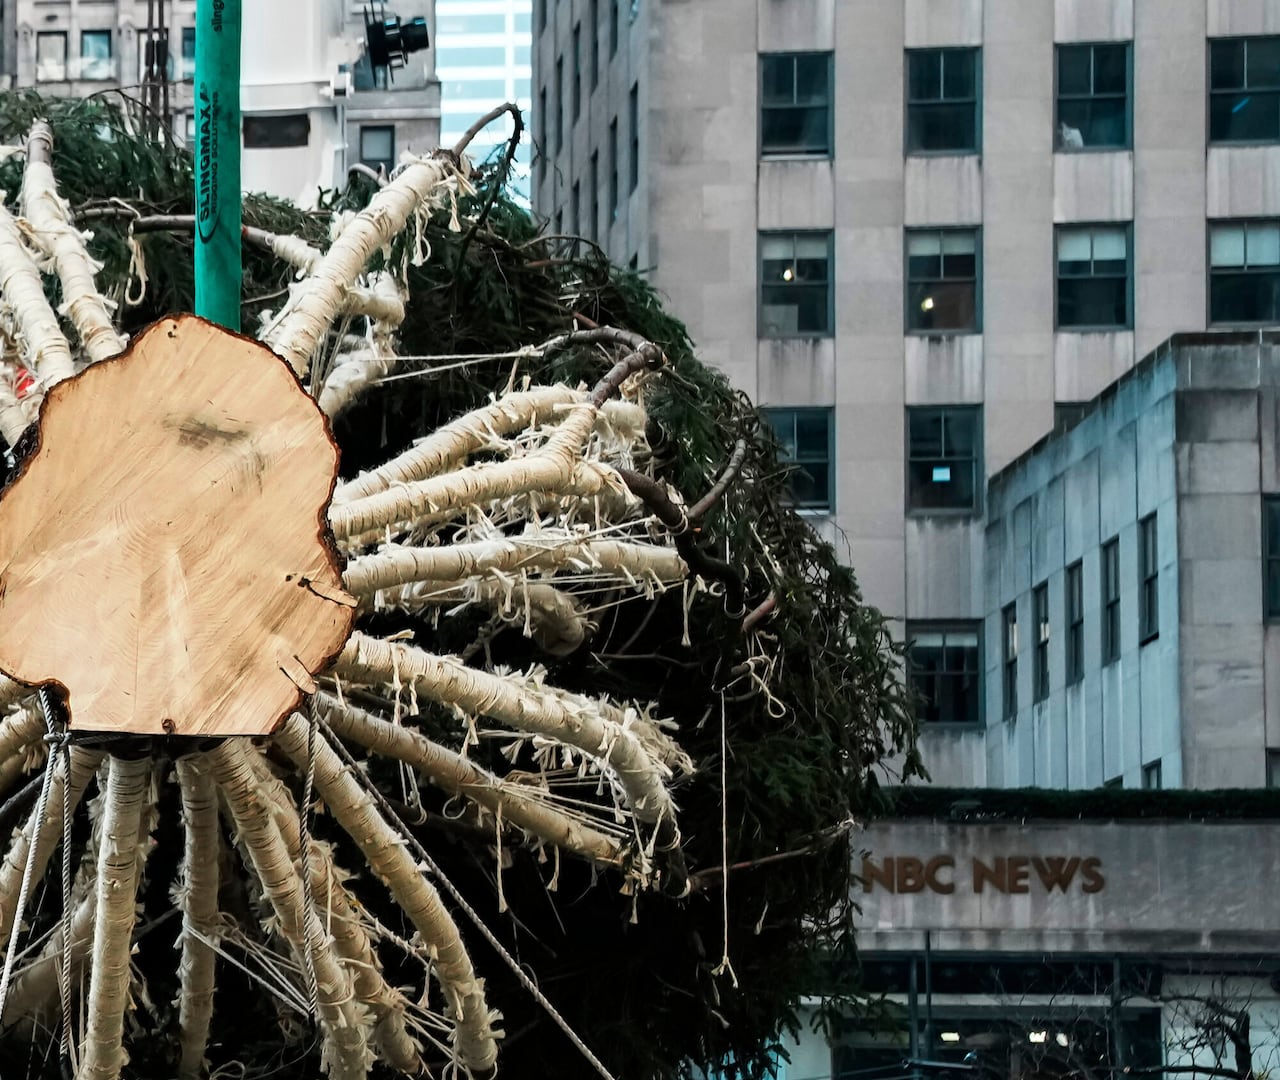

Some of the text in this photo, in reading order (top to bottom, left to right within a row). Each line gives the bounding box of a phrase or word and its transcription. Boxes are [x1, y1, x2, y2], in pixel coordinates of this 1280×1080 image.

[199, 104, 211, 223] SLINGMAX
[861, 855, 1106, 895] NBC NEWS
